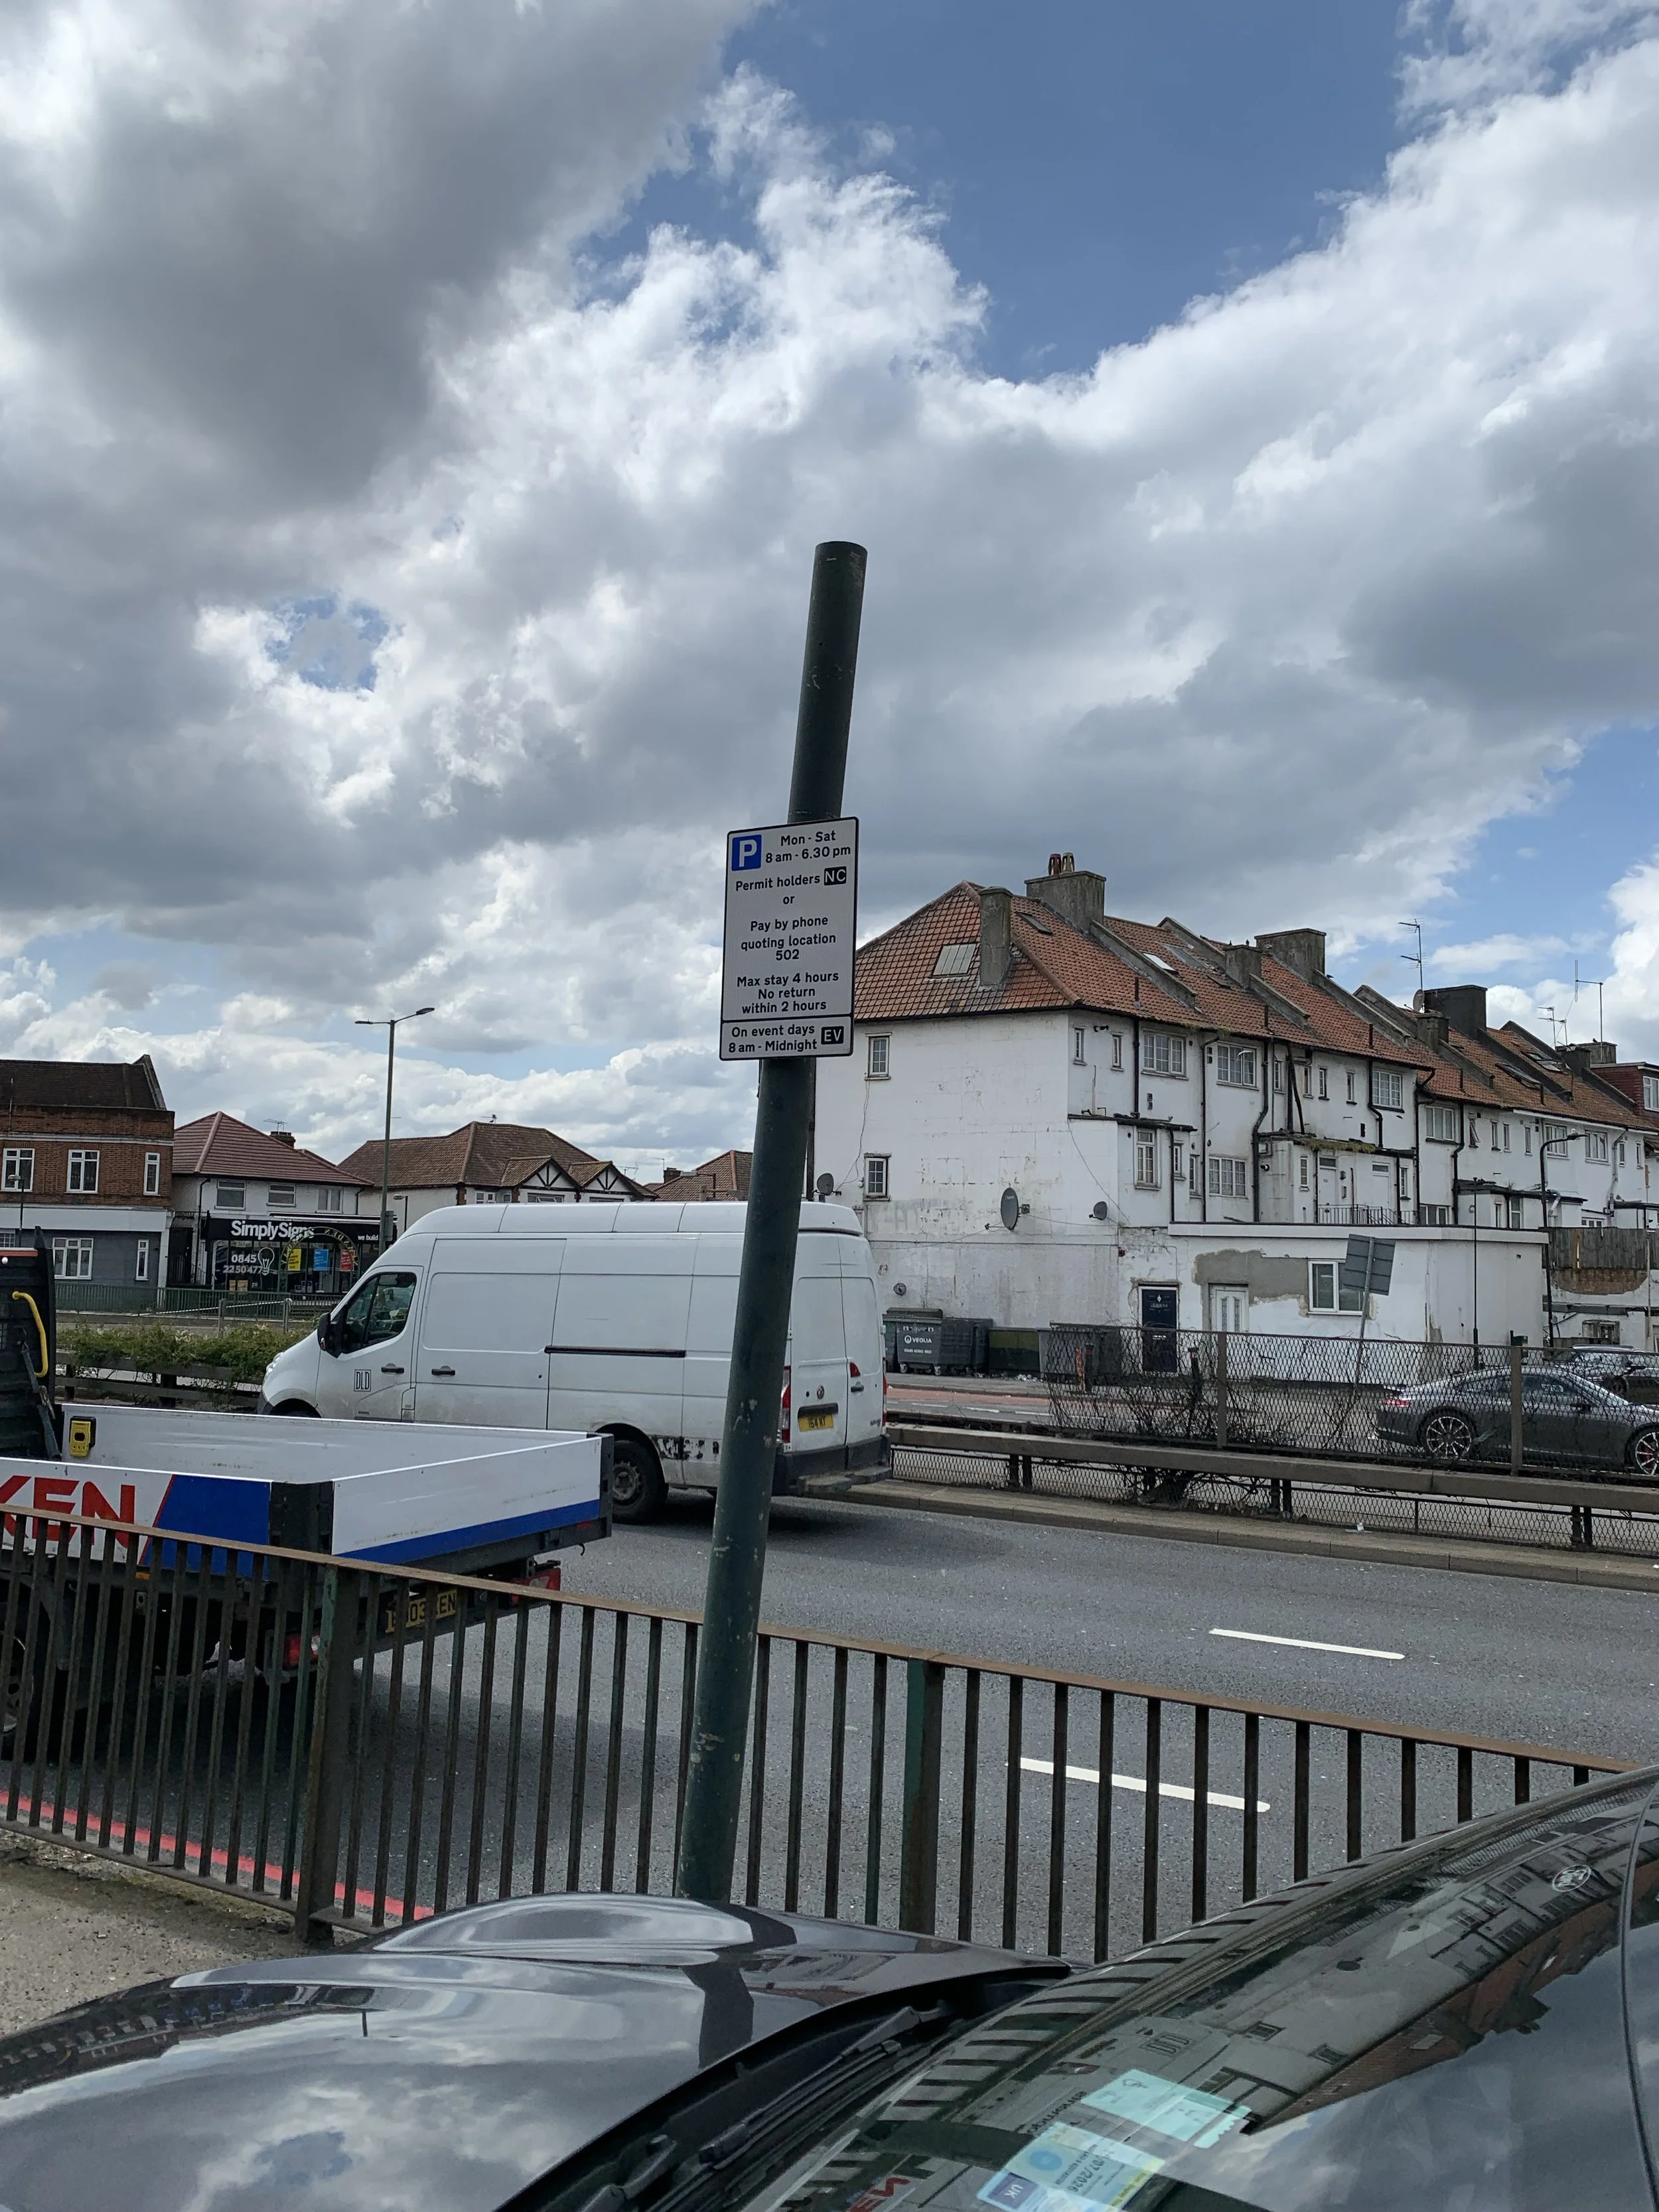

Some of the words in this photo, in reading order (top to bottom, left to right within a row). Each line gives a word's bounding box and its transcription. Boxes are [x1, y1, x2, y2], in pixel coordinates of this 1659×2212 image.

[780, 835, 805, 846] Mon
[815, 830, 836, 842] Sat
[739, 839, 757, 867] P
[765, 852, 772, 863] 8
[775, 852, 792, 862] am
[802, 846, 830, 859] 6.30
[832, 846, 851, 858] pm
[735, 877, 773, 891] Permit
[776, 874, 820, 888] holders
[824, 869, 847, 883] NC
[782, 896, 795, 905] or
[751, 921, 771, 932] Pay
[774, 919, 788, 930] by
[792, 917, 828, 930] phone
[741, 937, 784, 952] quoting
[788, 933, 836, 946] location
[775, 949, 800, 961] 502
[737, 976, 760, 987] Max
[764, 974, 789, 986] stay
[792, 972, 801, 983] 4
[805, 972, 839, 982] hours
[758, 989, 774, 999] No
[778, 988, 816, 998] return
[742, 1002, 777, 1014] within
[781, 1001, 789, 1012] 2
[793, 1001, 827, 1011] hours
[731, 1027, 747, 1037] On
[751, 1025, 784, 1036] event
[788, 1024, 815, 1036] days
[824, 1029, 842, 1042] EV
[729, 1042, 736, 1053] 8
[738, 1043, 755, 1053] am
[765, 1039, 818, 1052] Midnight
[231, 1254, 257, 1263] 0845
[356, 1371, 370, 1390] DLD
[1003, 2183, 1024, 2199] UK
